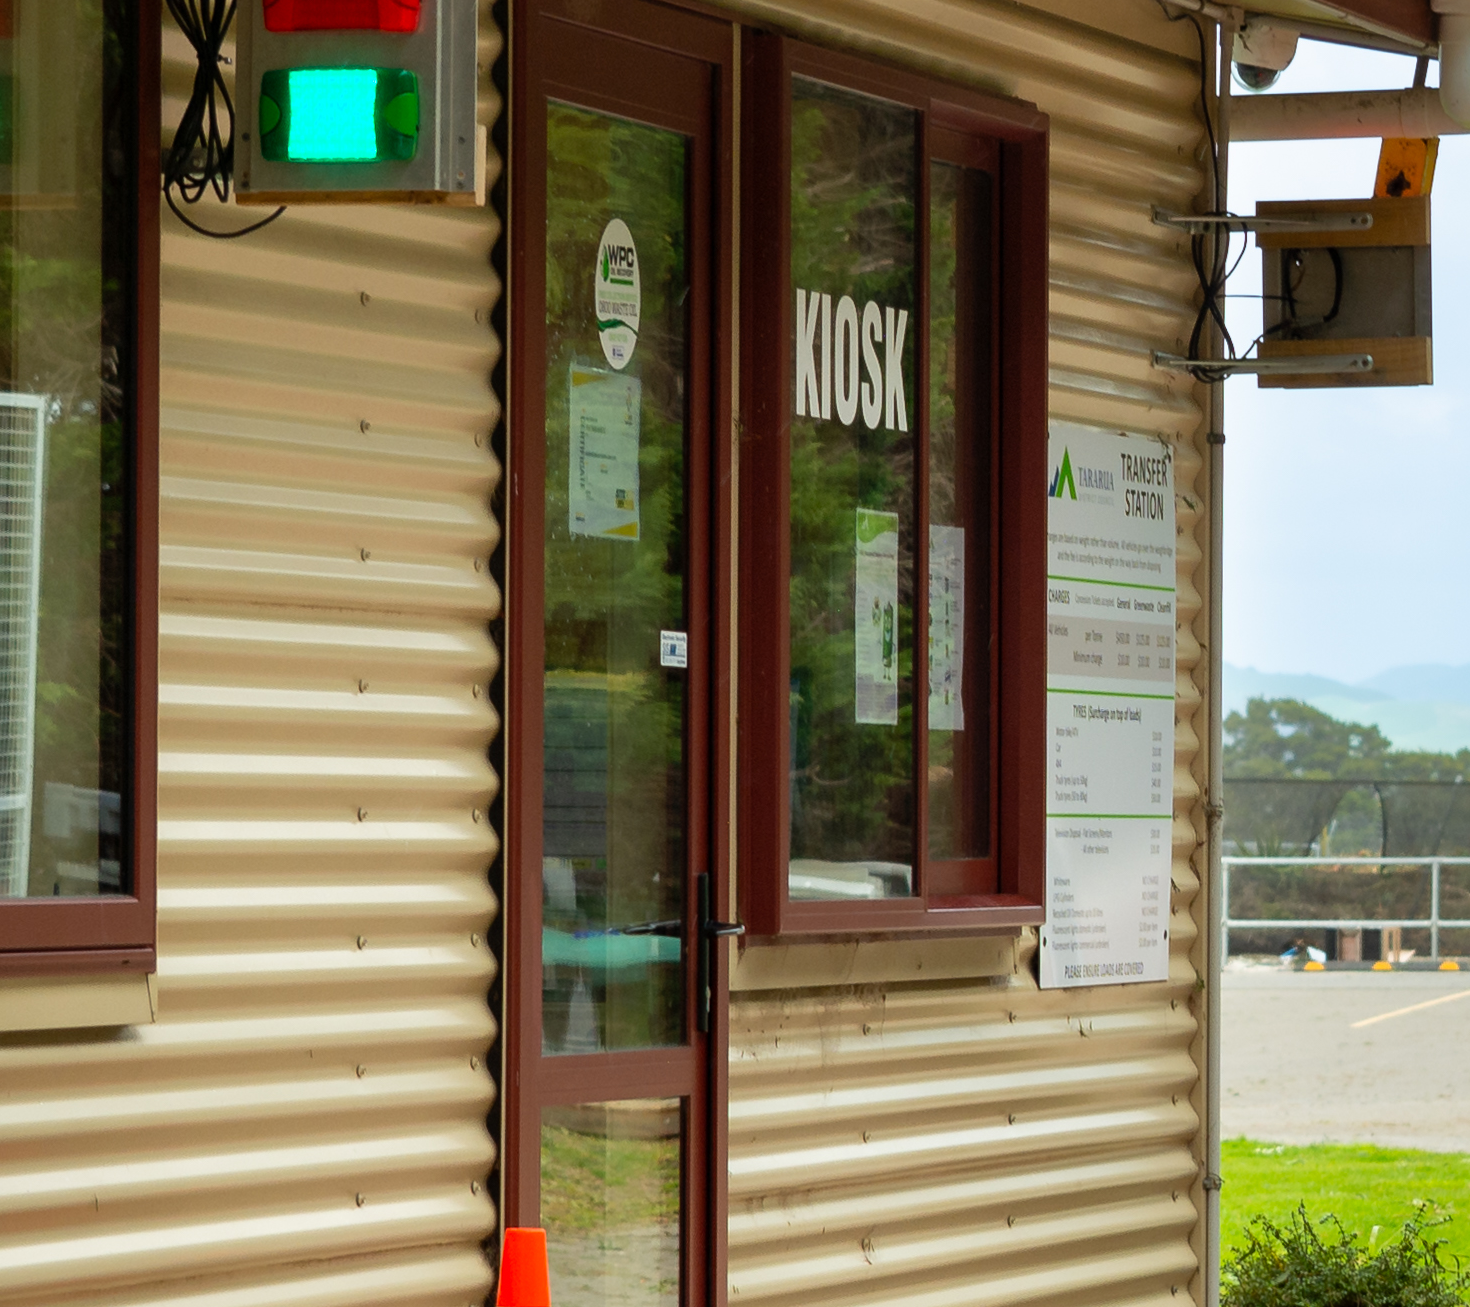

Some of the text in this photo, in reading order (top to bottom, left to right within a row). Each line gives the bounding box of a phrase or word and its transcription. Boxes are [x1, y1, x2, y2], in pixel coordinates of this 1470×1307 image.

[608, 245, 634, 268] WPC
[796, 288, 908, 432] KIOSK
[1078, 467, 1114, 491] TARARUA
[1121, 453, 1167, 487] TRANSFER
[1125, 489, 1164, 520] STATION
[1049, 589, 1070, 604] CHARGES
[1117, 597, 1130, 610] General
[1073, 705, 1087, 719] TYRES
[1065, 962, 1144, 979] PLEASE ENSURE LOADS ARE COVERED
